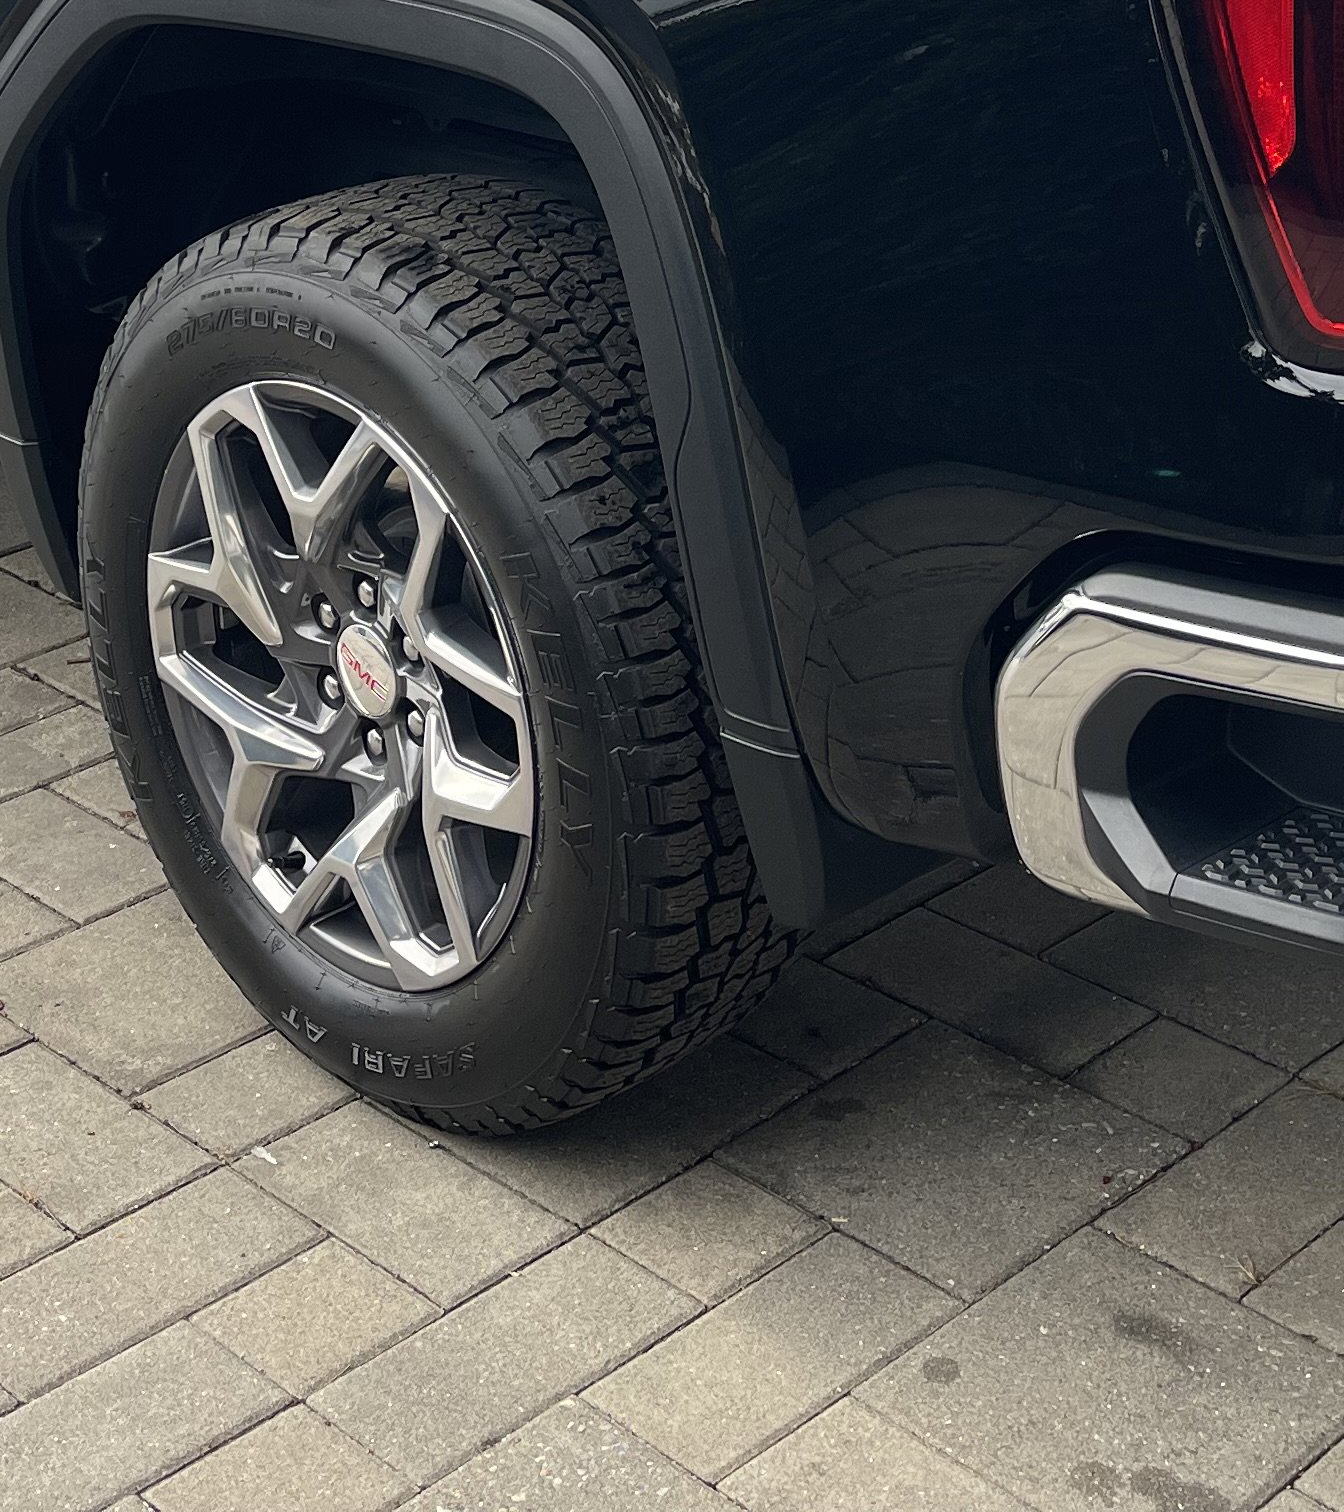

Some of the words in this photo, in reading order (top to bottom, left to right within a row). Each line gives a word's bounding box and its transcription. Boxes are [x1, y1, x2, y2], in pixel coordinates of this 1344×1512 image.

[165, 306, 337, 352] 275/60R20
[340, 642, 390, 703] GMC
[499, 551, 594, 883] KELLY
[351, 1041, 477, 1080] SAFARI
